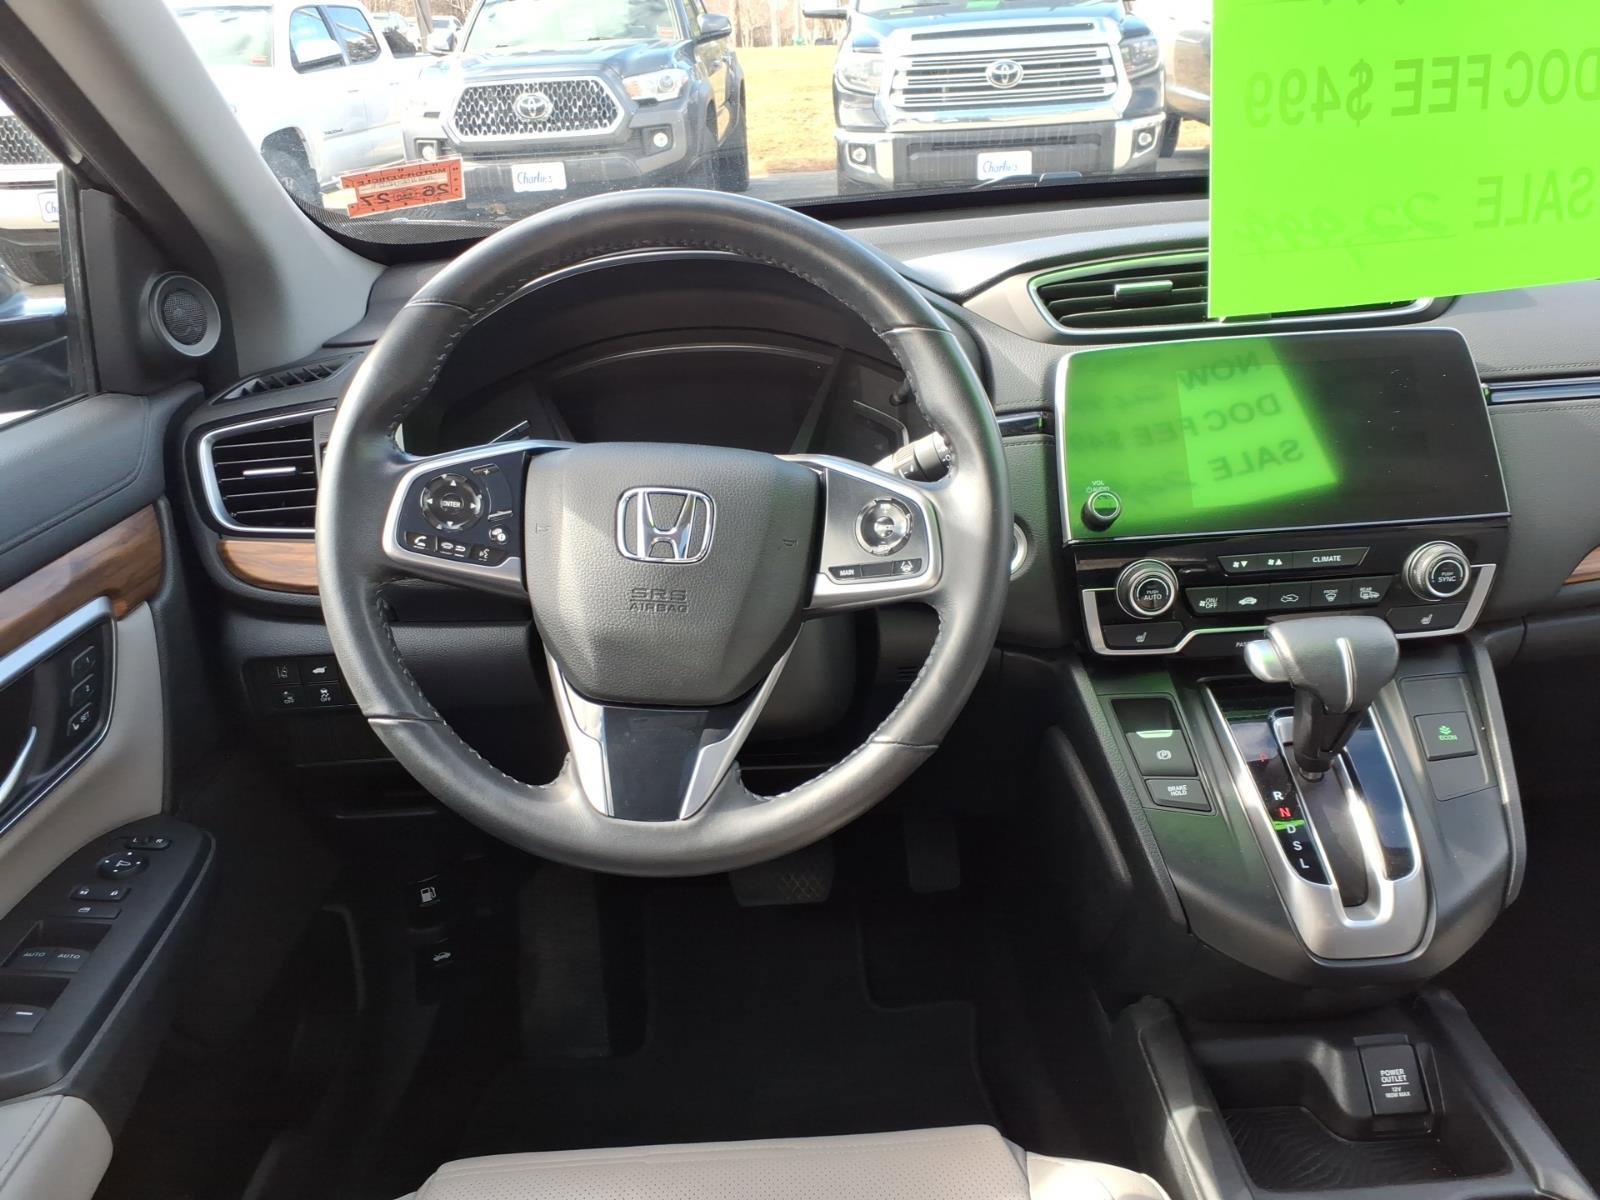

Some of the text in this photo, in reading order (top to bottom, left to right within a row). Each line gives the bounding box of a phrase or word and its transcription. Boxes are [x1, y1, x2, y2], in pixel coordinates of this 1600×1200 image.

[1312, 555, 1341, 563] CLIMATE
[631, 587, 687, 601] SRS
[629, 602, 688, 613] AIRBAG
[1272, 791, 1284, 801] R
[1279, 807, 1291, 818] N
[1286, 824, 1296, 834] D
[1292, 841, 1303, 851] S
[1299, 858, 1310, 869] L
[1381, 1075, 1407, 1083] OUTLET
